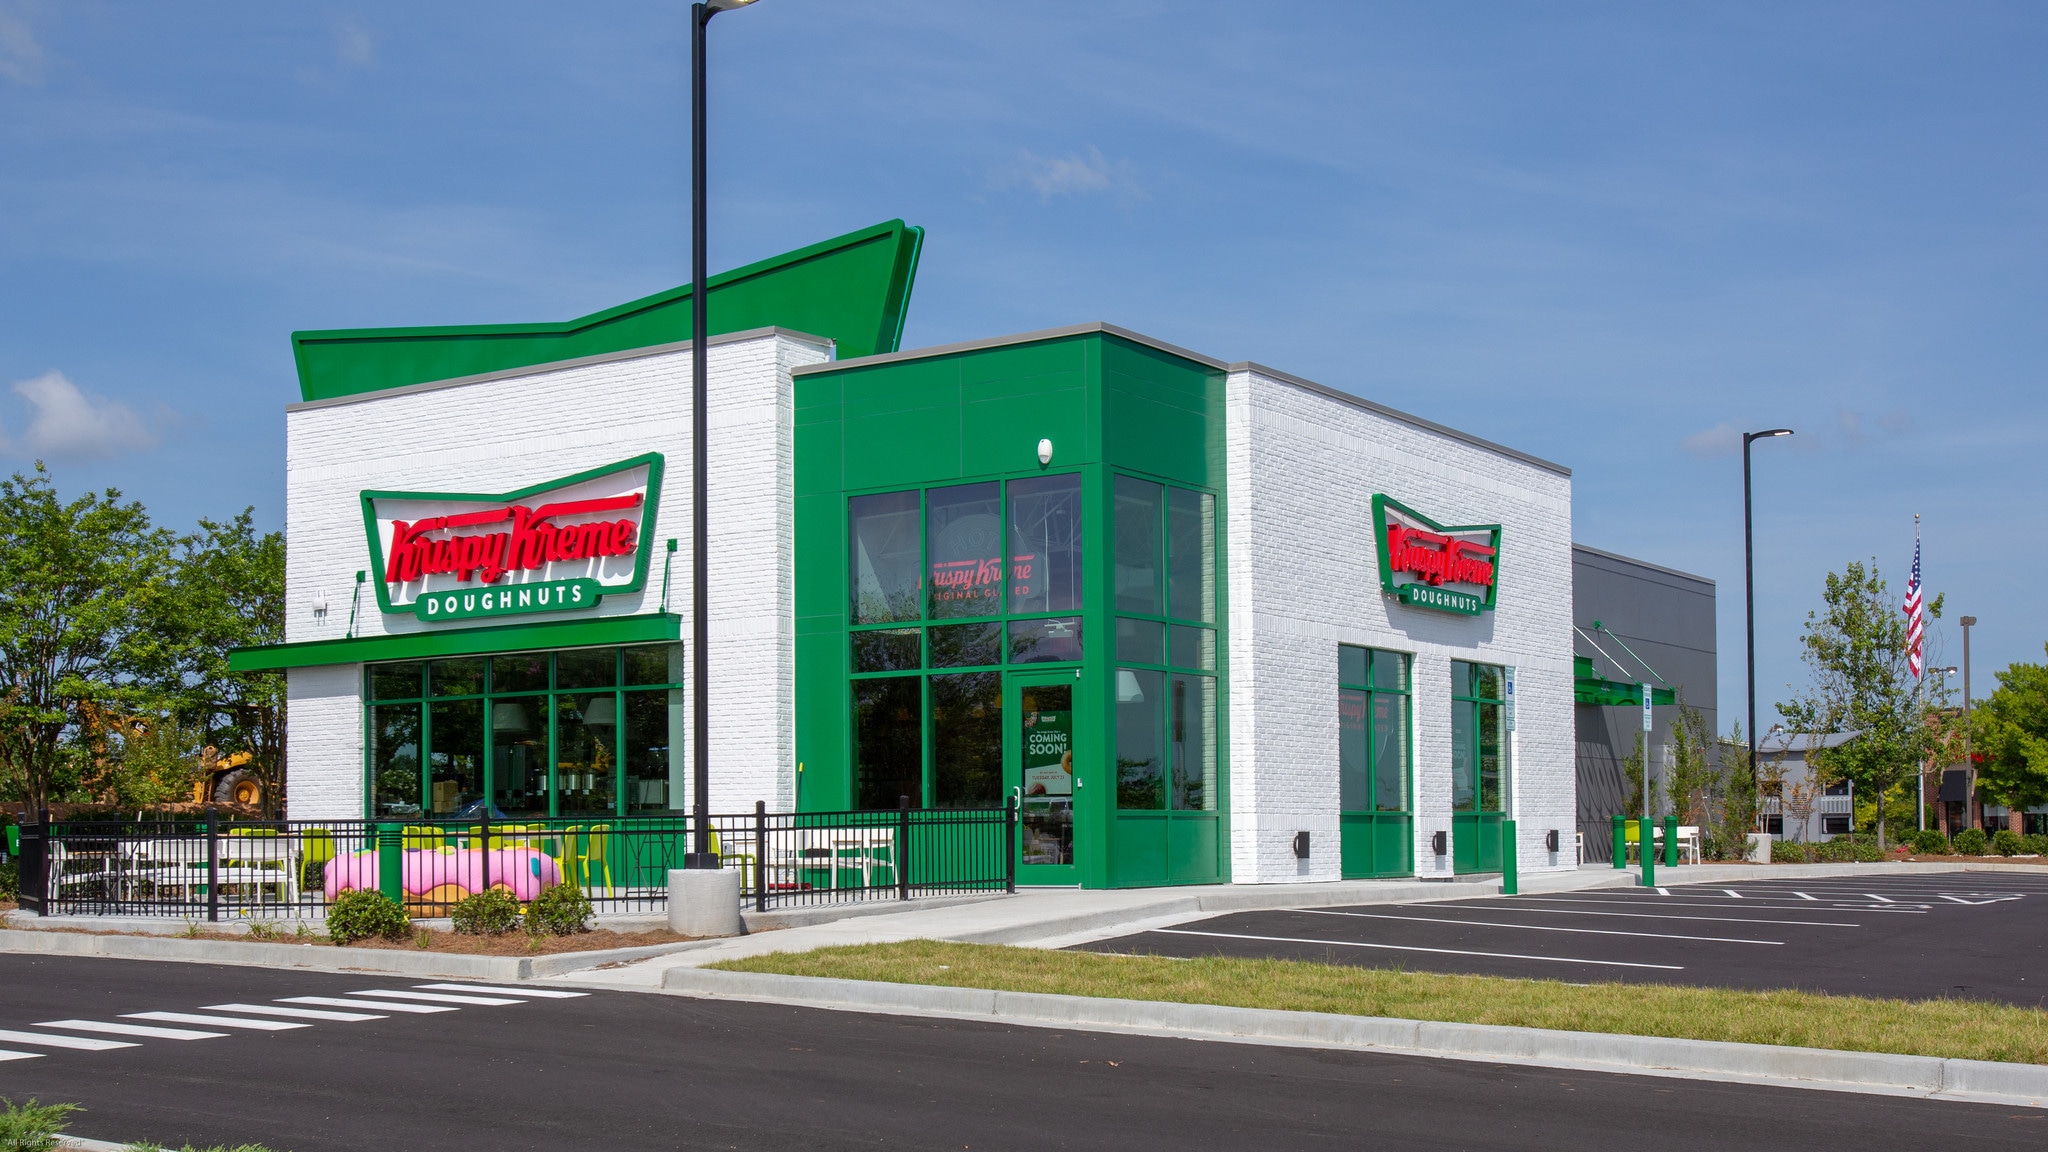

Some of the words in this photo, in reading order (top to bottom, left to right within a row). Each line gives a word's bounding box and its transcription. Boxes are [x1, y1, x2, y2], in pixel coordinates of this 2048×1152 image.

[385, 506, 514, 584] Krispy
[508, 492, 644, 571] Kreme
[1387, 523, 1449, 587] Krispy
[1445, 535, 1496, 586] Kreme
[976, 555, 1035, 586] Krme
[427, 584, 582, 616] DOUGHNUTS
[984, 586, 1030, 598] GLED
[1413, 588, 1477, 612] DOUGHNUTS
[1029, 733, 1067, 743] COMING
[1029, 743, 1067, 755] SOON!
